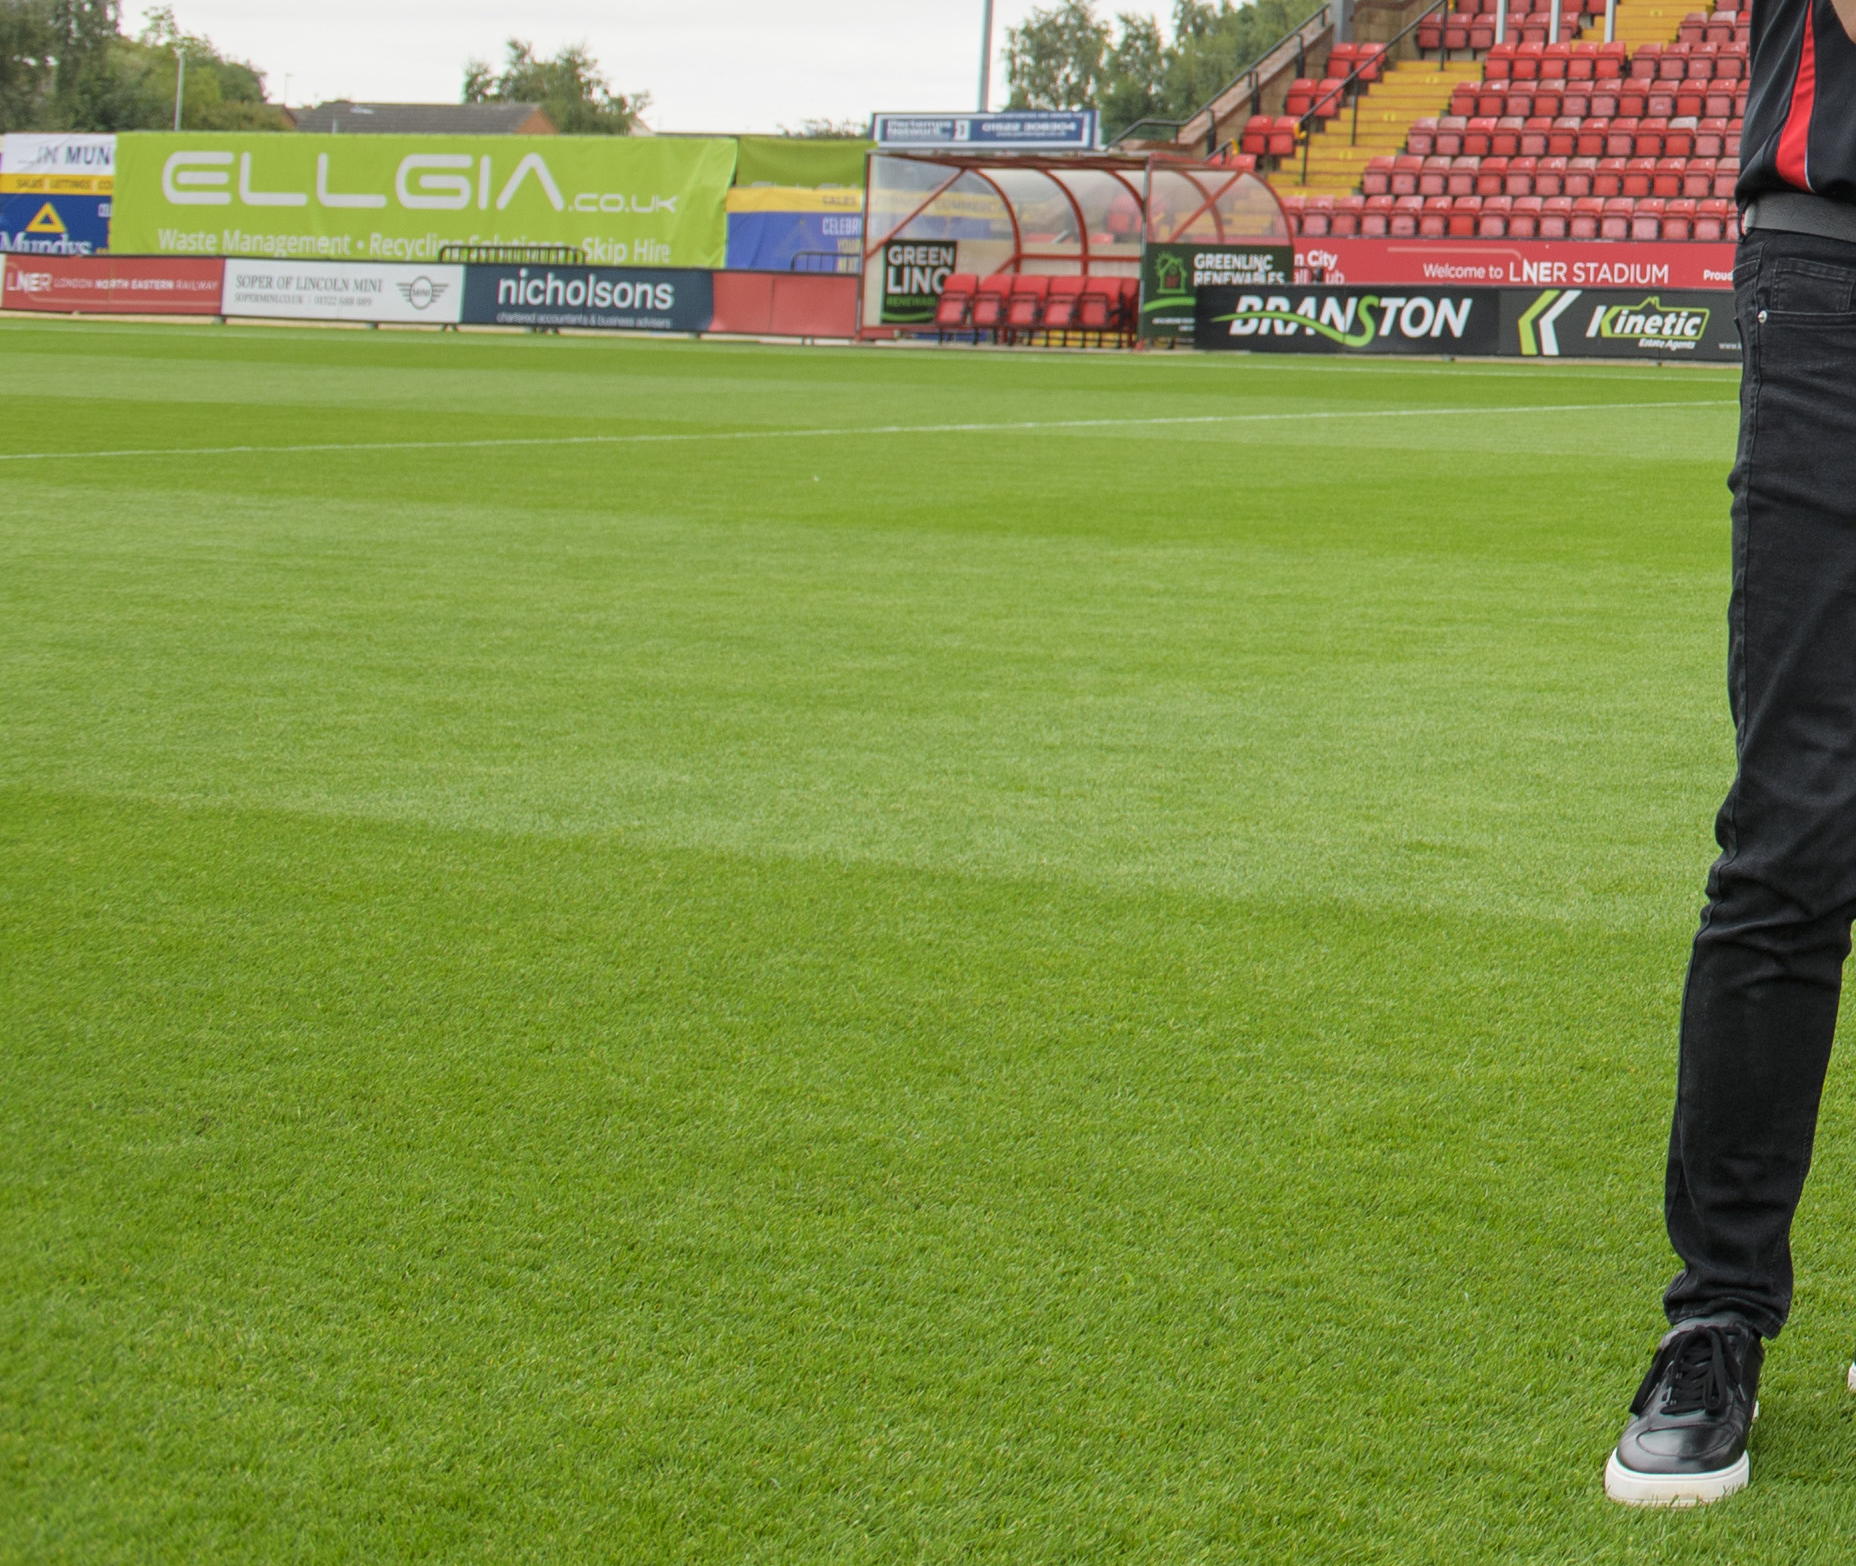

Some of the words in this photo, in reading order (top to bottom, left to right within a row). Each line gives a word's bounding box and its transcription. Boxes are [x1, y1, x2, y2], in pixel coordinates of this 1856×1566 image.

[158, 229, 217, 252] Waste
[222, 230, 351, 257] Management
[582, 238, 629, 264] Skip
[634, 239, 672, 263] Hire
[887, 245, 955, 267] GREEN
[1194, 252, 1274, 270] GREENLINC
[1307, 249, 1338, 271] City
[1423, 263, 1484, 280] Welcome
[1489, 265, 1503, 280] to
[1510, 259, 1568, 285] LNER
[1572, 262, 1670, 284] STADIUM
[7, 271, 53, 293] LNER
[236, 273, 274, 290] SOPER
[277, 275, 294, 291] OF
[296, 275, 352, 292] LINCOLN
[356, 277, 383, 293] MINI
[497, 267, 674, 310] nicholsons
[1224, 293, 1473, 348] BRANSTON
[1586, 304, 1702, 338] Kinetic
